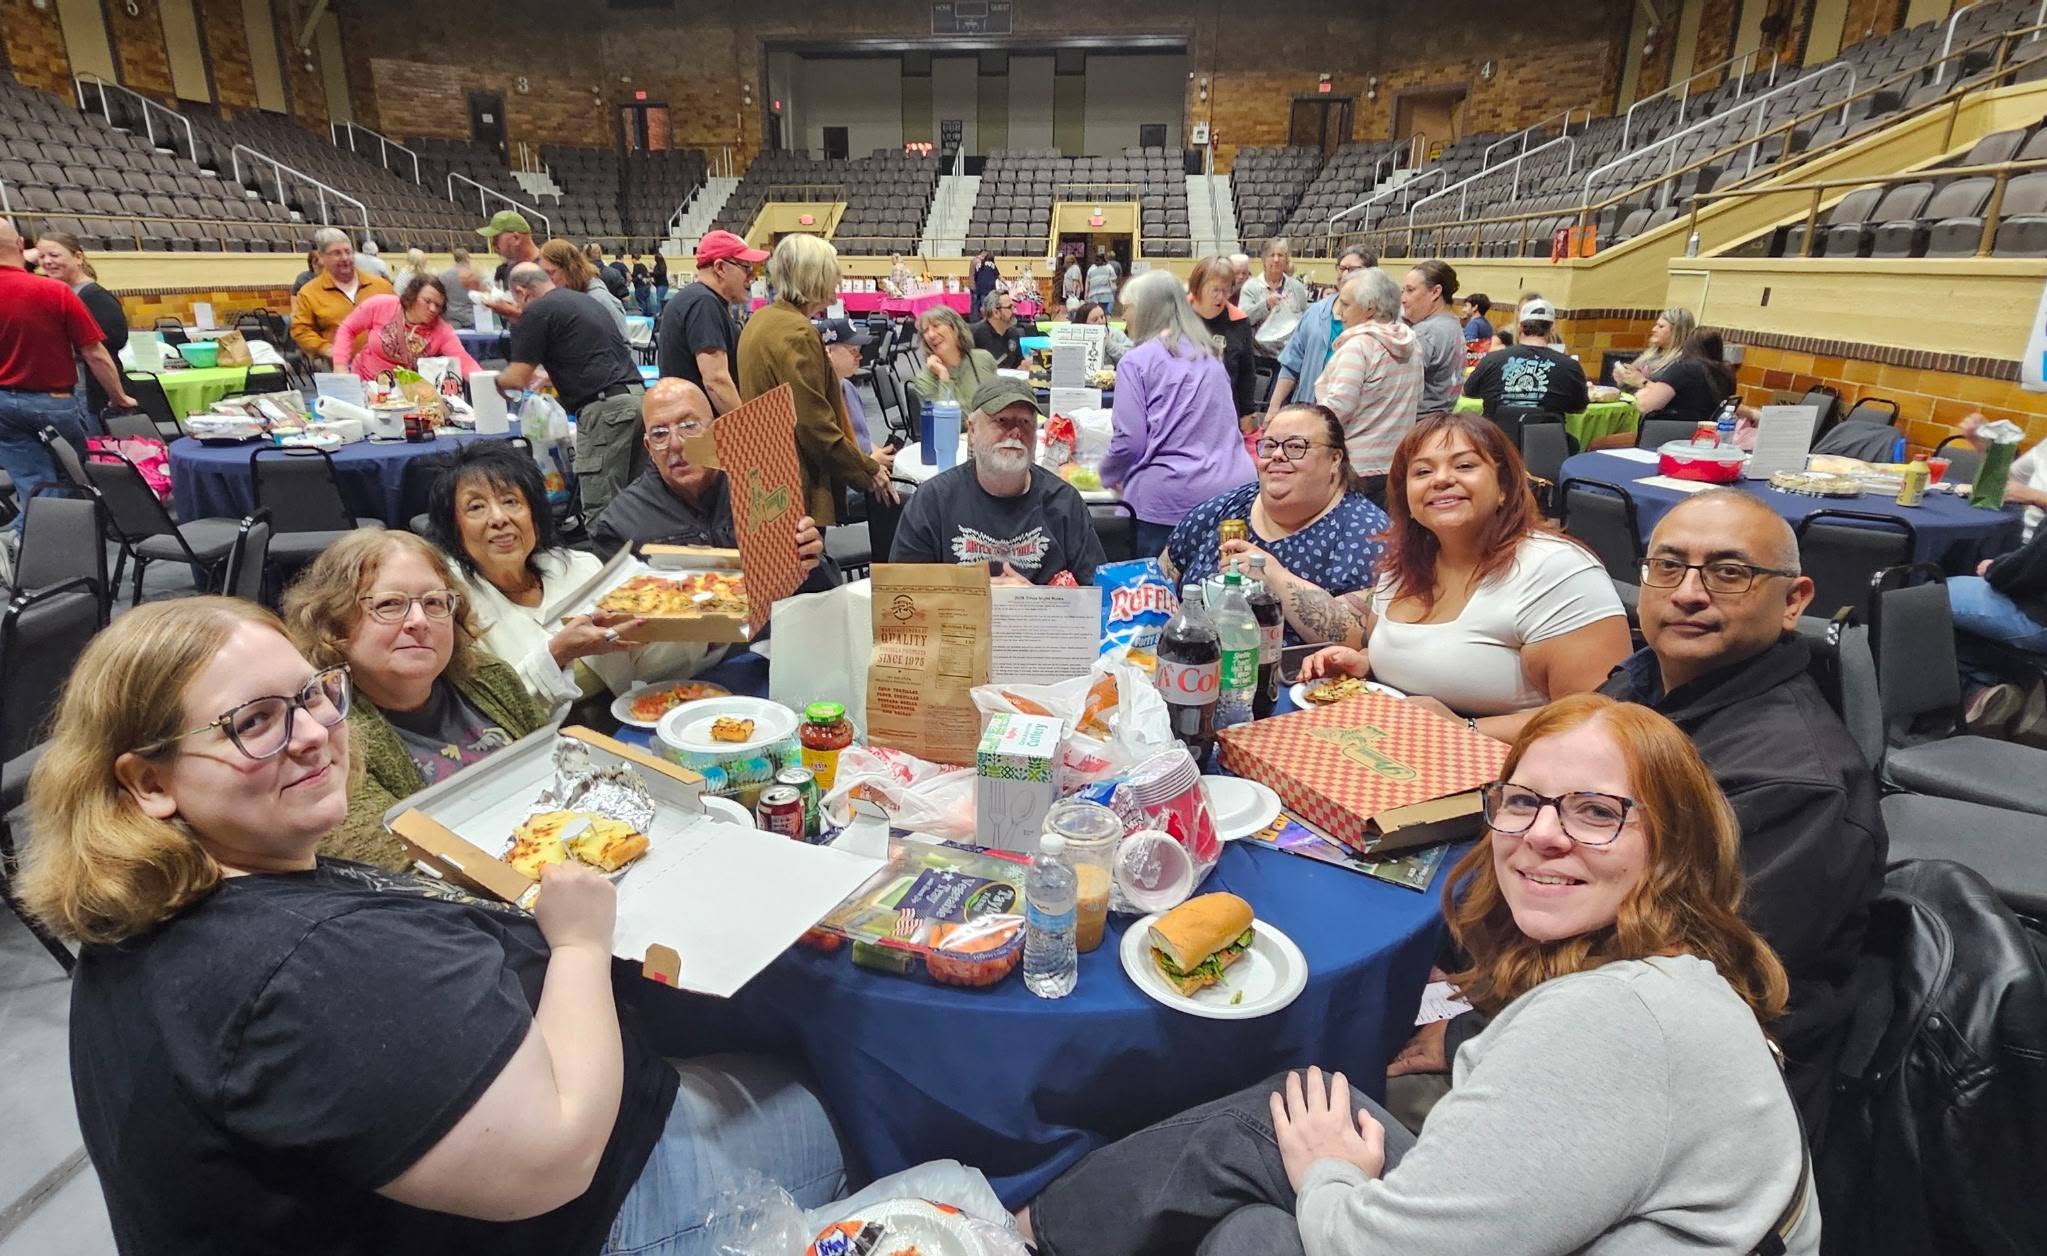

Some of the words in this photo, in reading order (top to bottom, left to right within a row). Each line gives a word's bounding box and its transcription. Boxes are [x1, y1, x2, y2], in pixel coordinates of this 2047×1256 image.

[1480, 60, 1491, 79] 4
[517, 76, 529, 94] 3
[881, 632, 928, 647] QUALITY
[878, 653, 904, 665] SINCE
[905, 655, 925, 667] 1975
